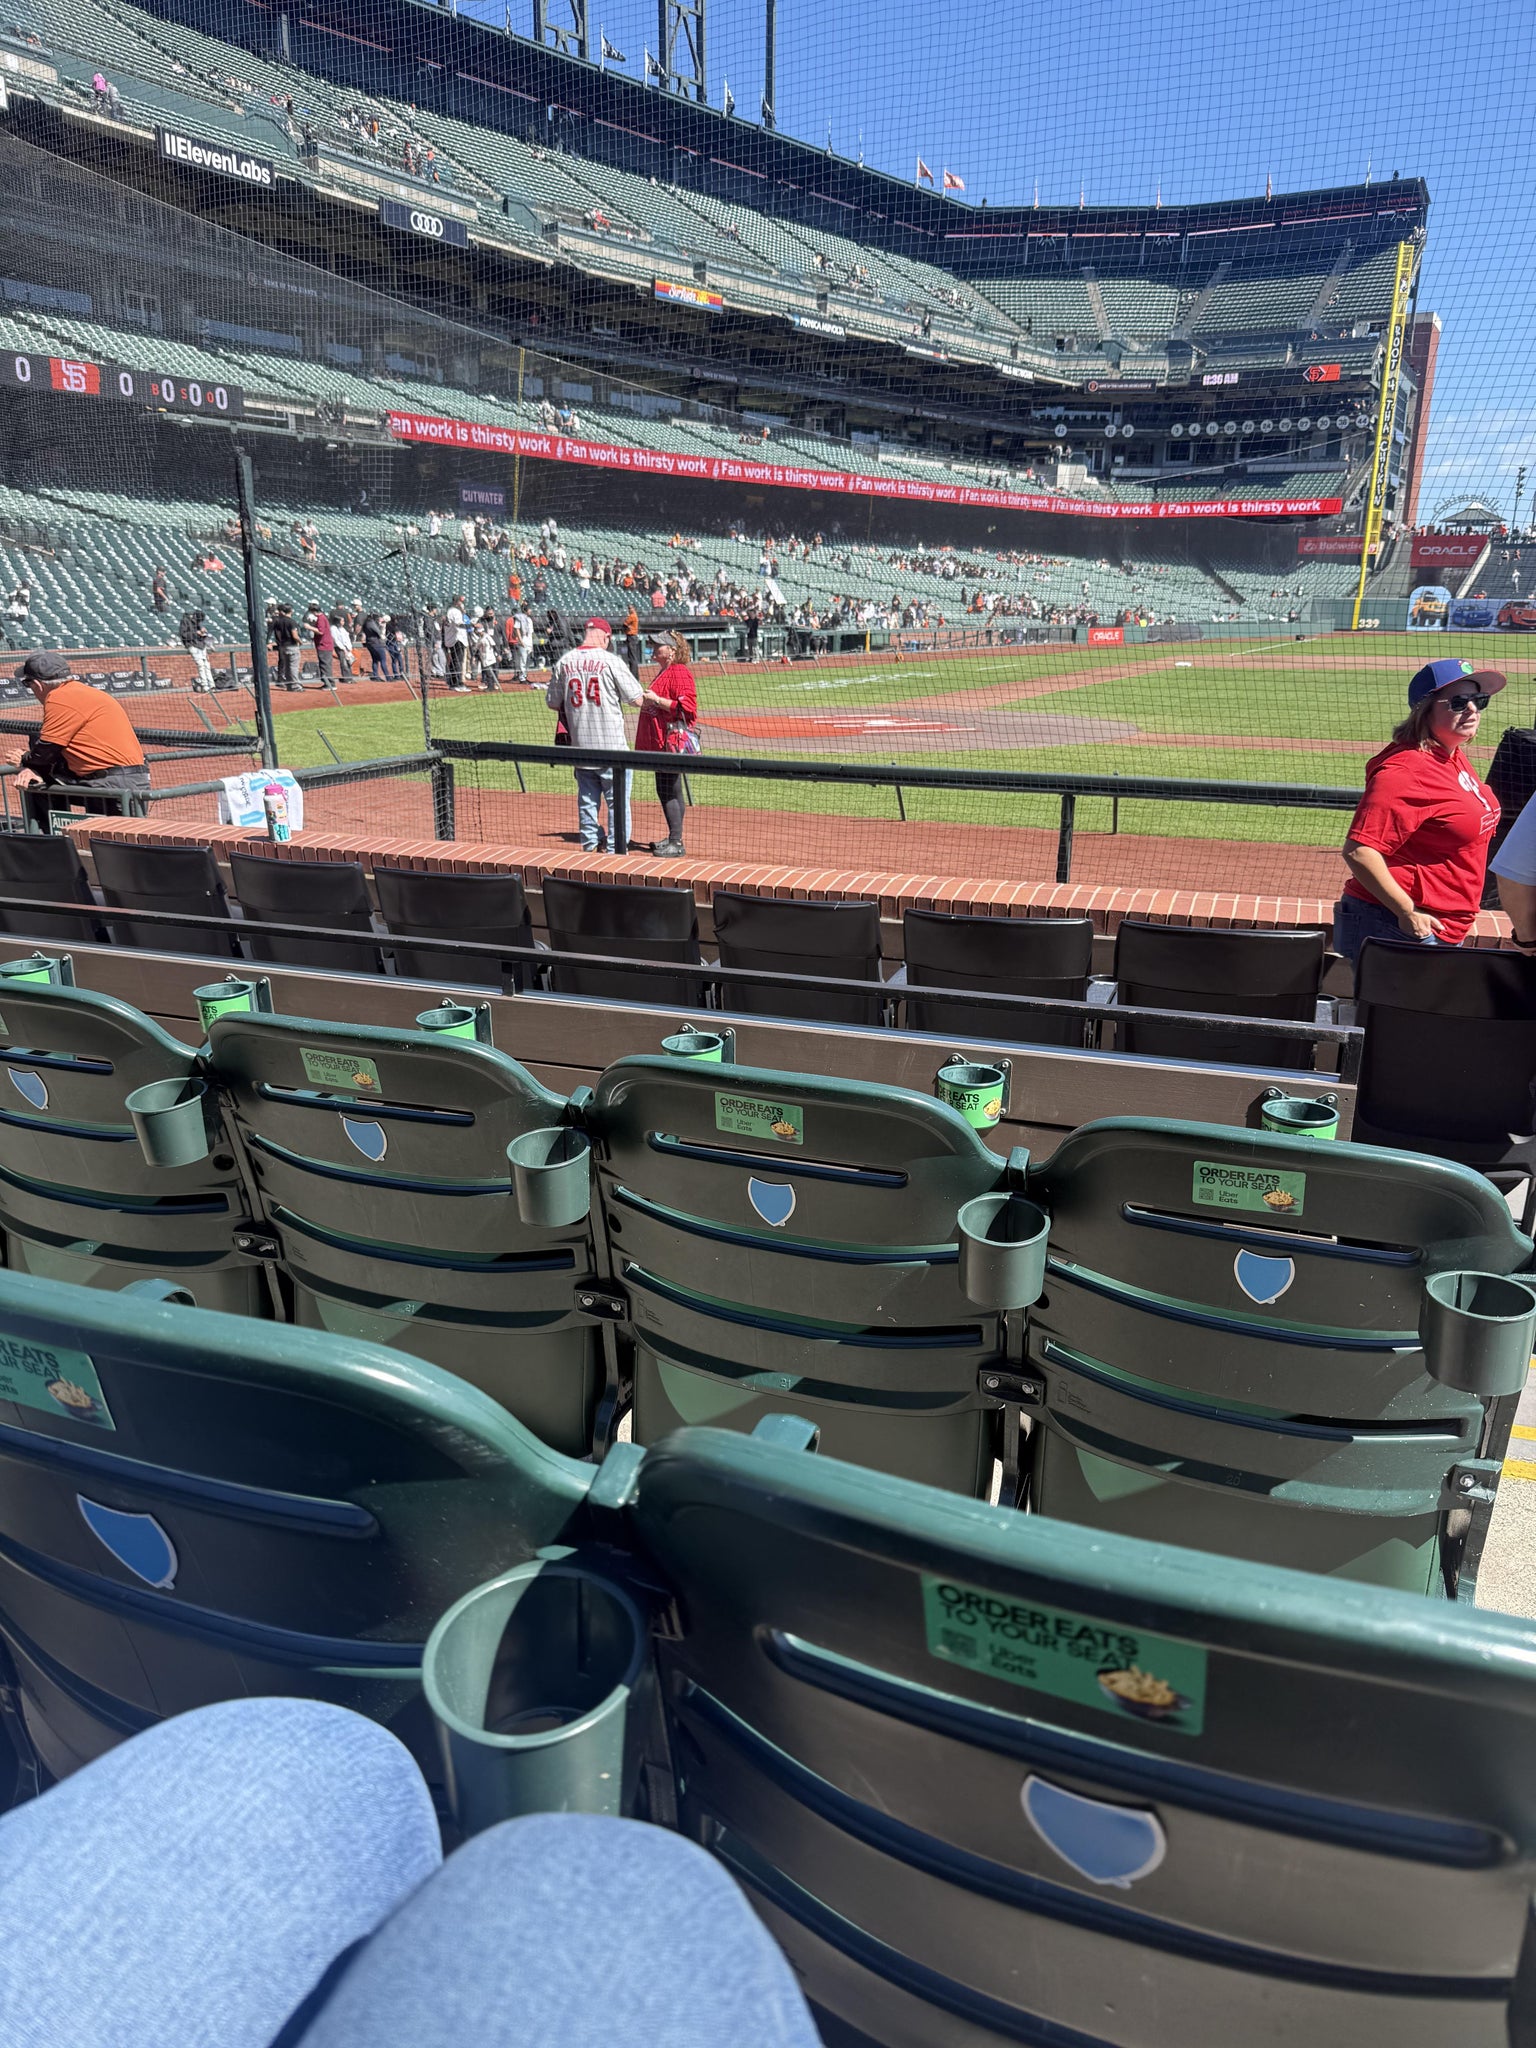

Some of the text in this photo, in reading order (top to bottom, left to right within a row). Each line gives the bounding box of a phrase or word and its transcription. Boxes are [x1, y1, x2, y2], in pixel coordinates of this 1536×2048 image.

[15, 356, 31, 382] 0
[119, 372, 134, 397] 0
[152, 383, 160, 396] B
[161, 379, 175, 403] 0
[189, 383, 201, 407] 0
[215, 387, 228, 410] 0
[1223, 372, 1239, 384] AM
[1388, 378, 1395, 391] 4
[388, 416, 551, 453] an work is thirsty work
[566, 442, 707, 473] Fan work is thirsty work
[721, 462, 844, 488] Fan work is thirsty work
[856, 477, 956, 499] Fan work is thirsty work
[966, 489, 1049, 509] Fan work is thirsty work
[1121, 503, 1152, 515] work
[1167, 501, 1321, 514] Fan work is thirsty work
[1320, 541, 1366, 551] Budweise
[1419, 546, 1479, 555] ORACLE
[1358, 619, 1380, 628] 339
[1093, 631, 1120, 641] ORACLE
[564, 659, 606, 676] ALLADAY
[568, 677, 601, 708] 34
[203, 1005, 218, 1014] ATS
[305, 1052, 360, 1068] ORDER EATS
[321, 1062, 341, 1071] YOUR
[342, 1065, 360, 1073] SEAT
[953, 1091, 980, 1103] EATS
[720, 1097, 783, 1116] ORDER EATS
[721, 1106, 783, 1122] TO YOUR SEAT
[956, 1102, 979, 1111] SEAT
[736, 1118, 752, 1126] Uber
[1200, 1166, 1280, 1184] ORDER EATS
[1200, 1175, 1279, 1191] TO YOUR SEAT
[1219, 1190, 1238, 1198] Uber
[1219, 1196, 1238, 1204] Eats
[8, 1341, 60, 1369] EATS
[22, 1359, 61, 1380] SEAT
[937, 1583, 1139, 1657] ORDER EATS
[939, 1601, 1138, 1671] TO YOUR SEAT
[988, 1642, 1036, 1666] Uber
[991, 1657, 1037, 1679] Eats
